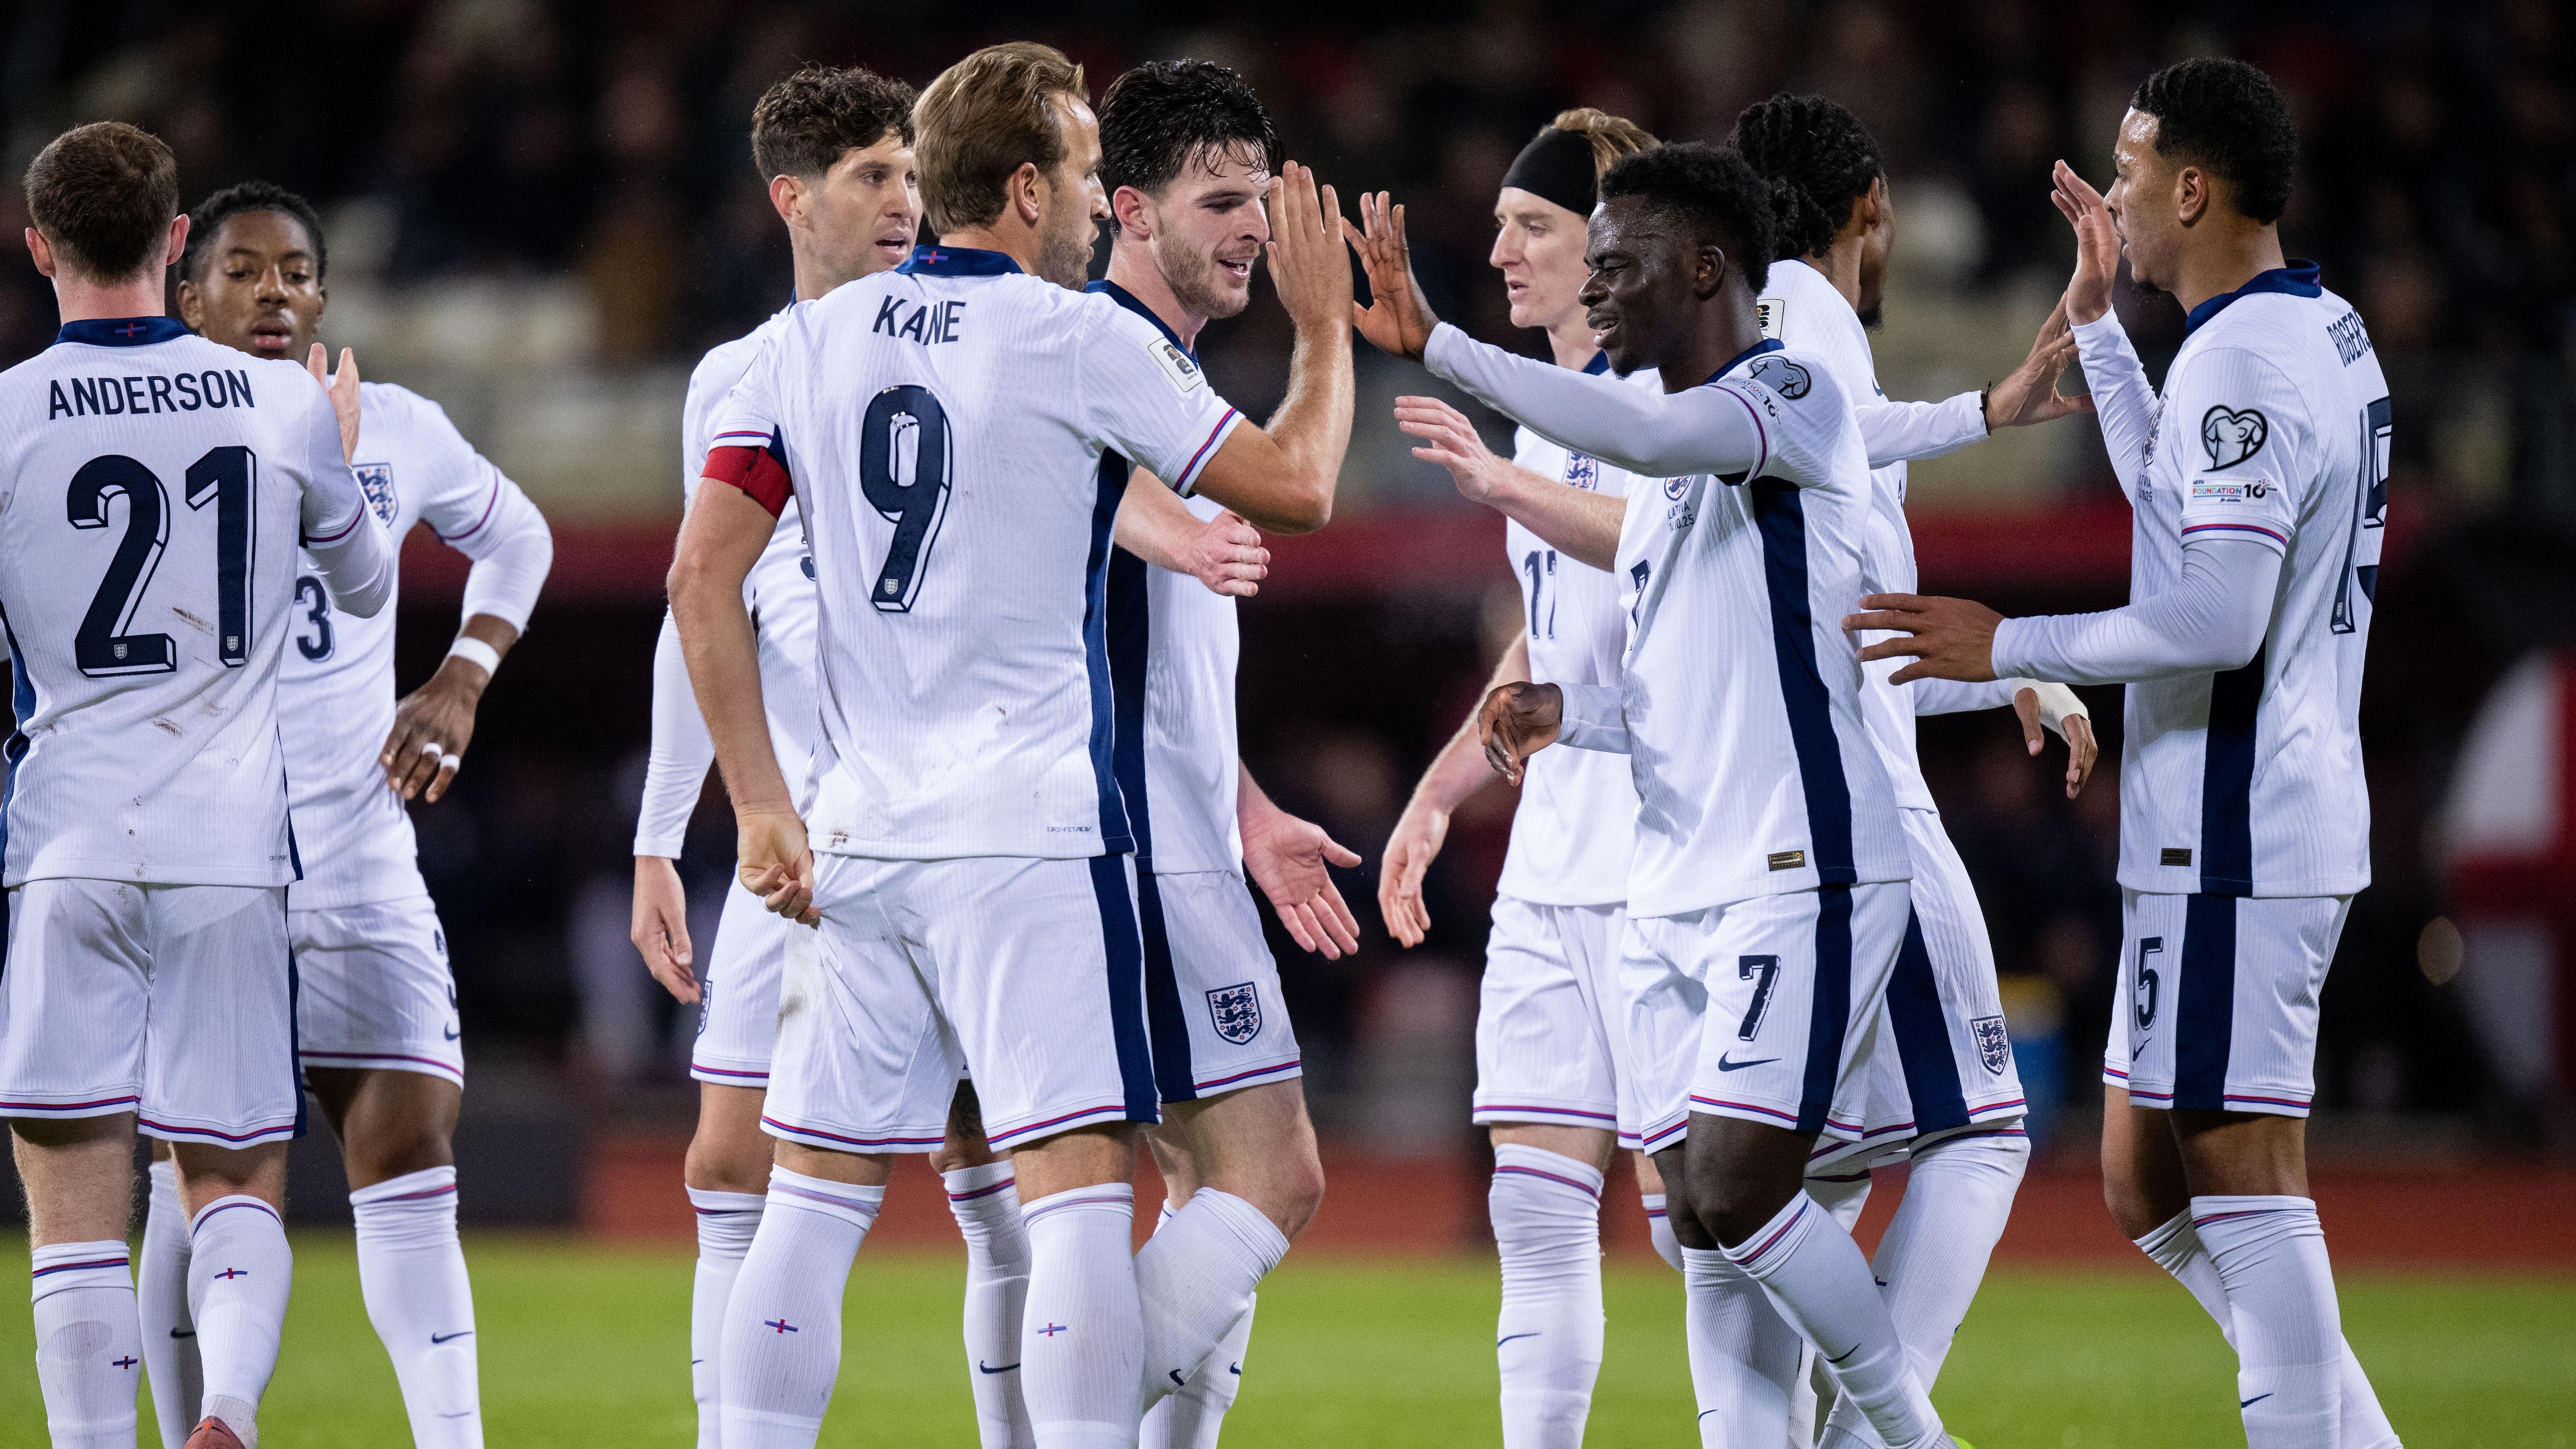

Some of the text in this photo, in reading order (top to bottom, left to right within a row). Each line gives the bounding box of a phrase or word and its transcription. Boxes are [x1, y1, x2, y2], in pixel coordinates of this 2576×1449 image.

[873, 295, 966, 345] KANE
[49, 369, 255, 419] ANDERSON
[860, 384, 953, 613] 9
[2244, 483, 2266, 498] 10
[66, 446, 257, 678] 21
[1629, 559, 1651, 651] 7
[294, 575, 335, 663] 3
[1738, 954, 1781, 1041] 7
